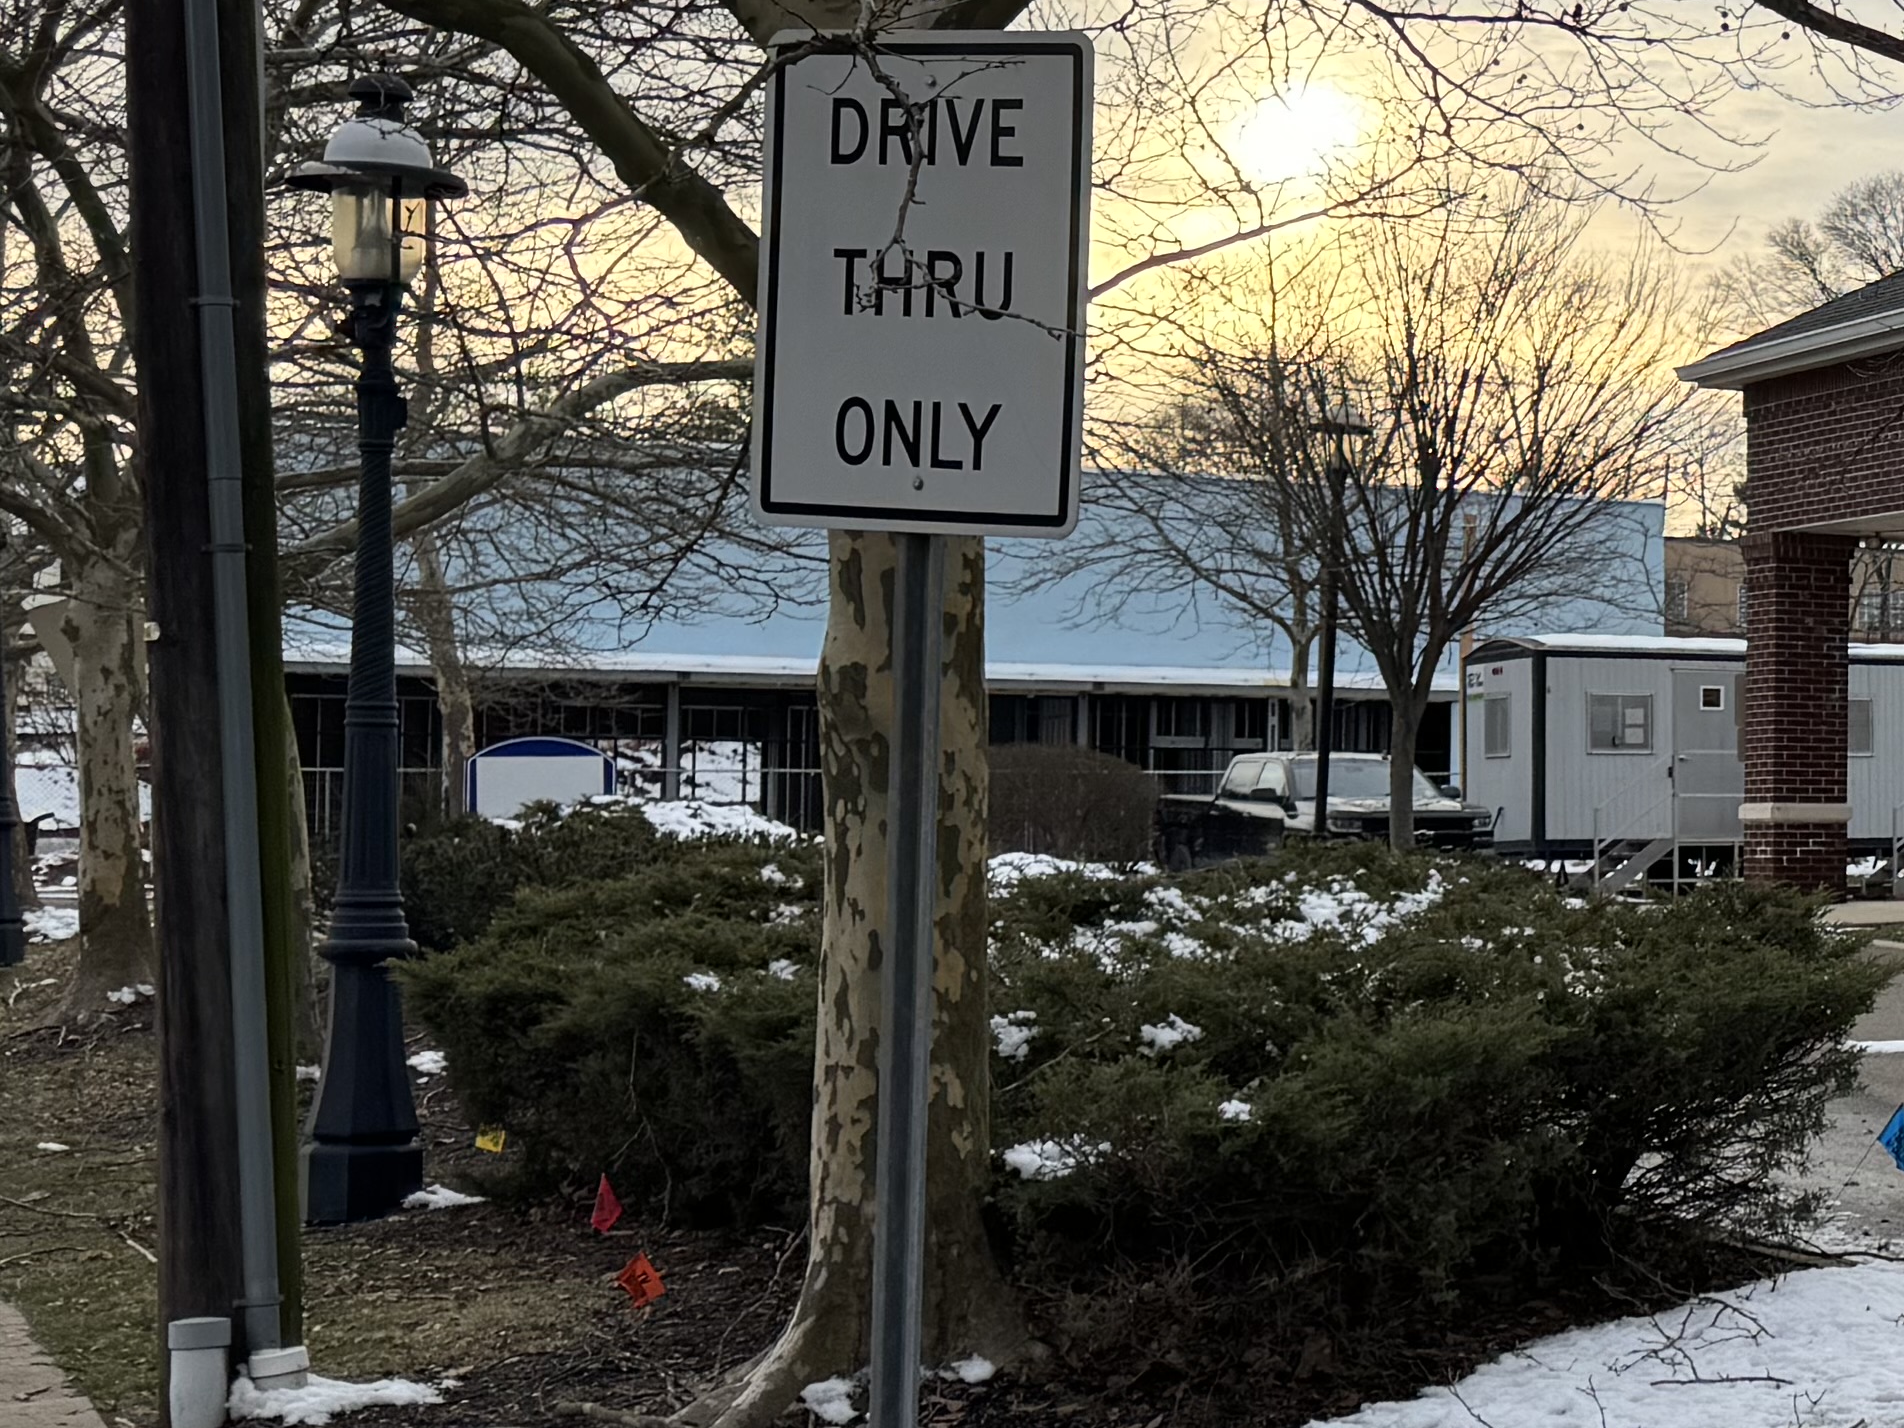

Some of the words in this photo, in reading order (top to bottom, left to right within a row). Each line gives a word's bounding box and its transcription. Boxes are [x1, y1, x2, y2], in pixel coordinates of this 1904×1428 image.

[830, 98, 1024, 167] DRIVE
[833, 249, 1014, 320] THRU
[835, 397, 1002, 471] ONLY
